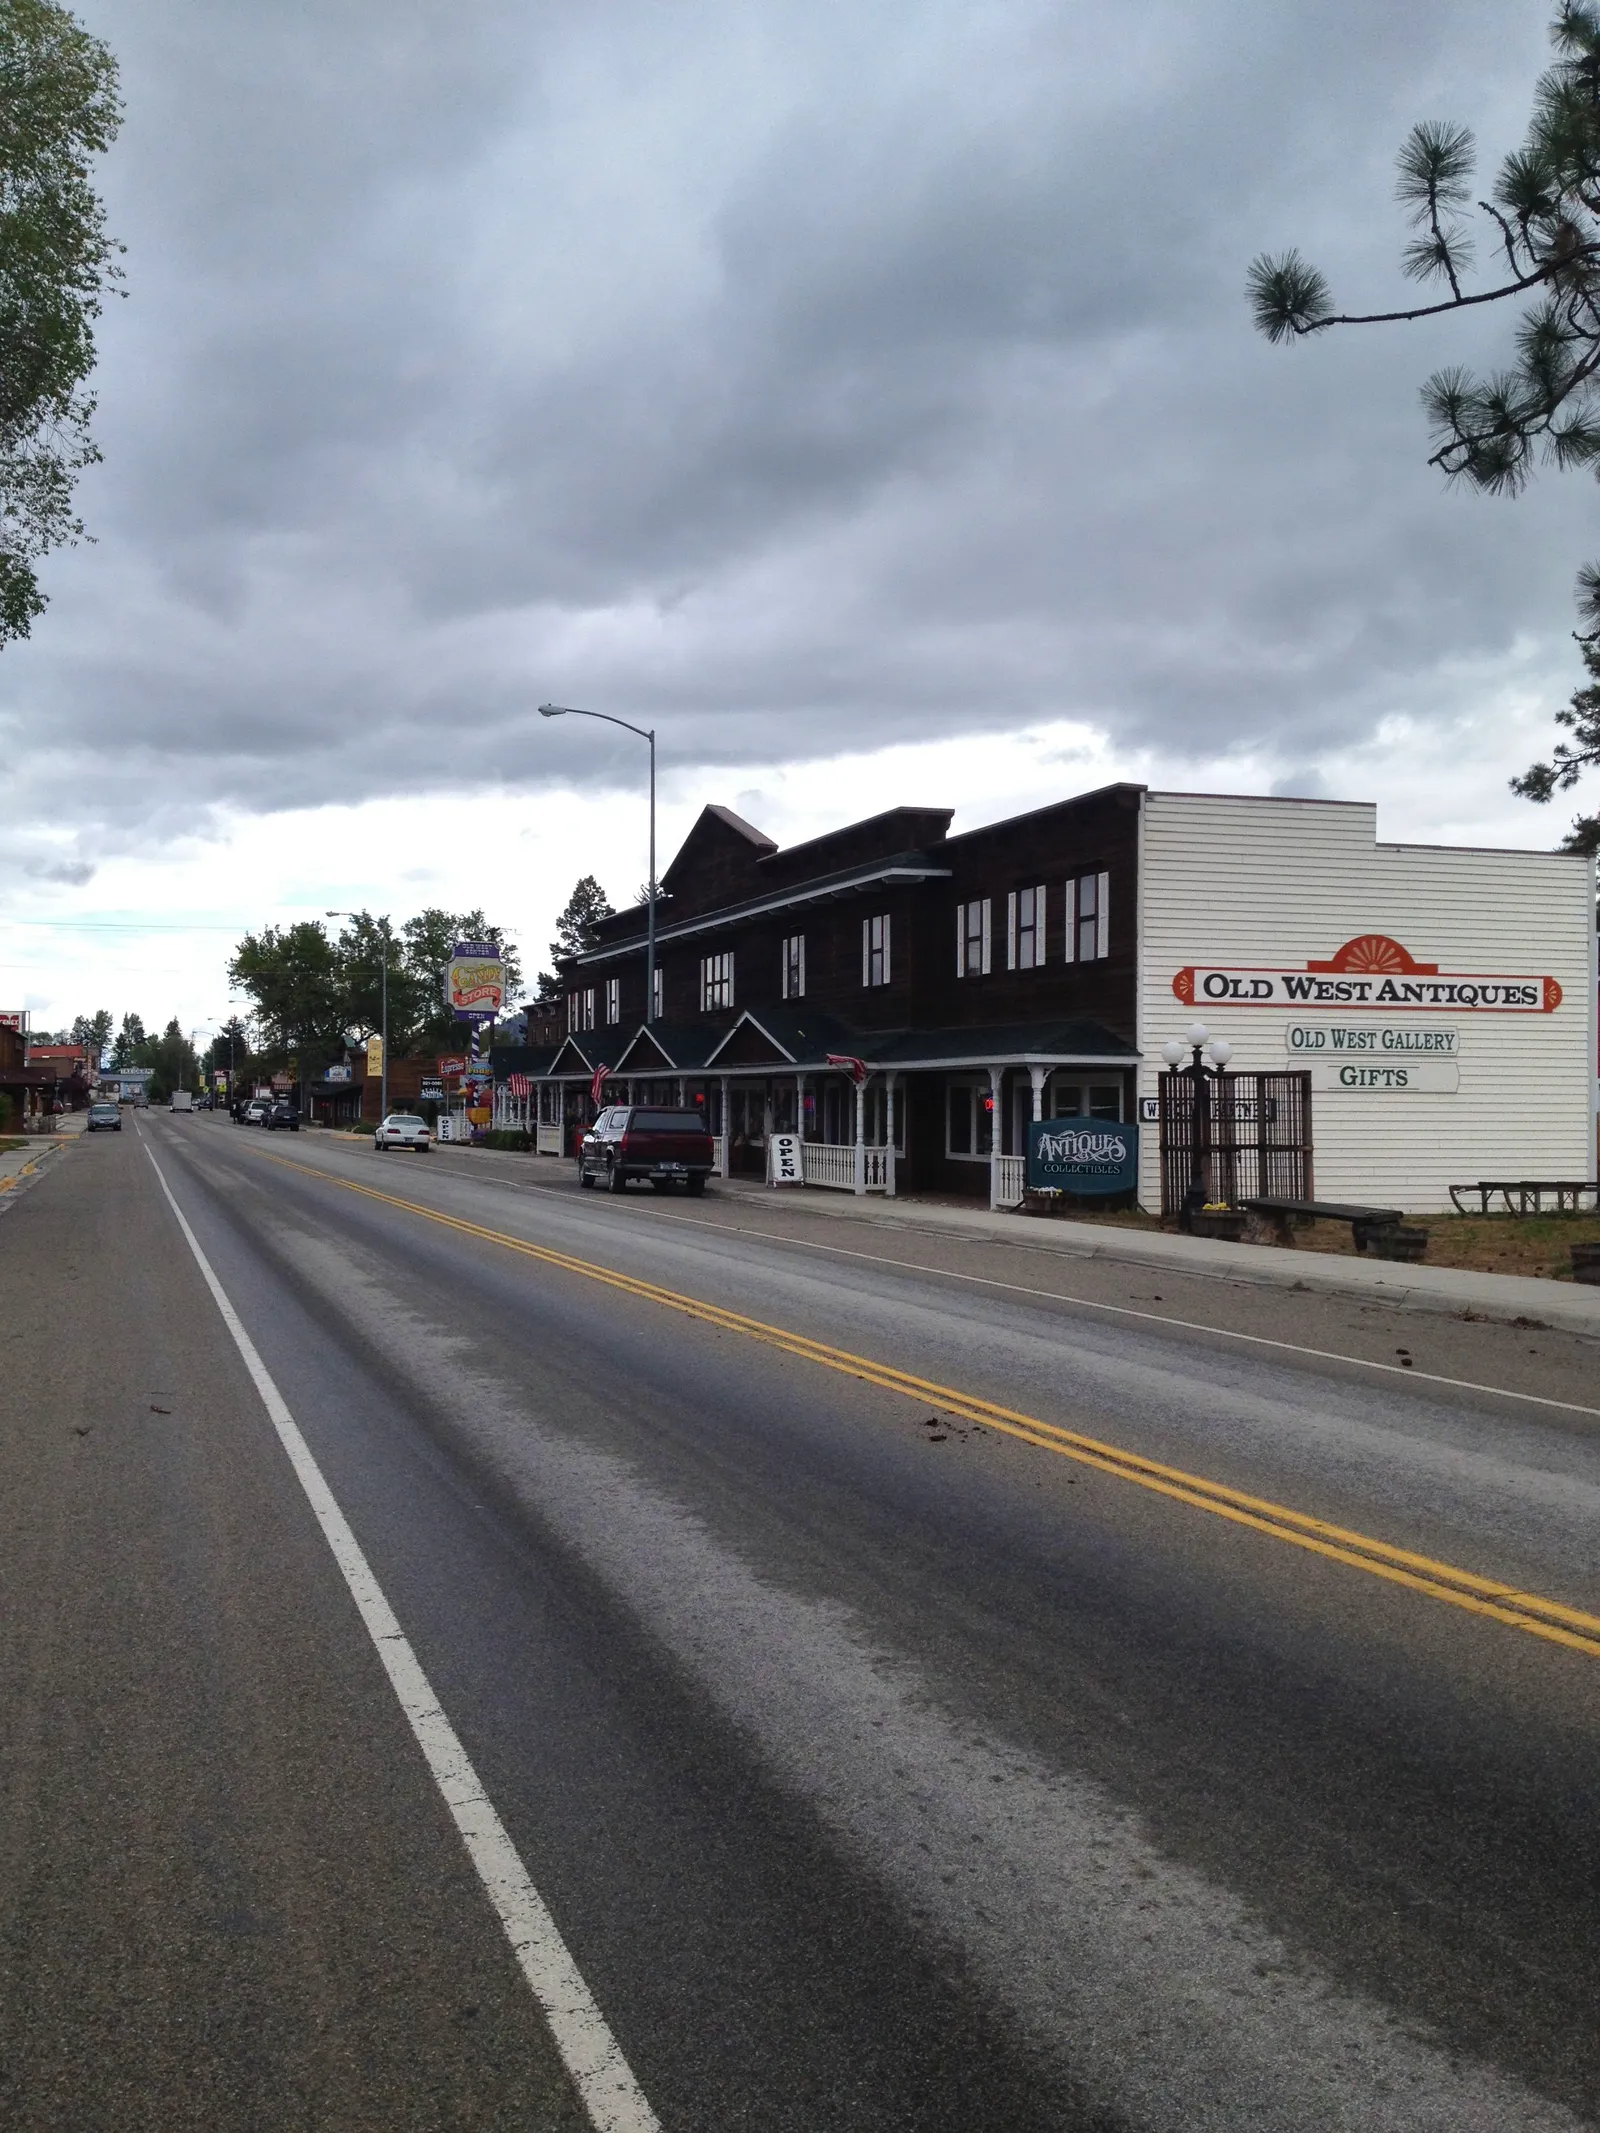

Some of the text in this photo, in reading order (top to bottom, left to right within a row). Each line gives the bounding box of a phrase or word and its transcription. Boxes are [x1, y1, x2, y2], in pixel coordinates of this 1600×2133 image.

[461, 988, 497, 1005] STORE
[1203, 973, 1538, 1006] OLD WEST ANTIQUES
[1291, 1027, 1455, 1051] OLD WEST GALLERY
[1339, 1065, 1409, 1087] GIFTS
[779, 1138, 795, 1177] OPEN
[1037, 1130, 1126, 1162] ANTIQUES
[1044, 1163, 1120, 1175] COLLECTIBLES
